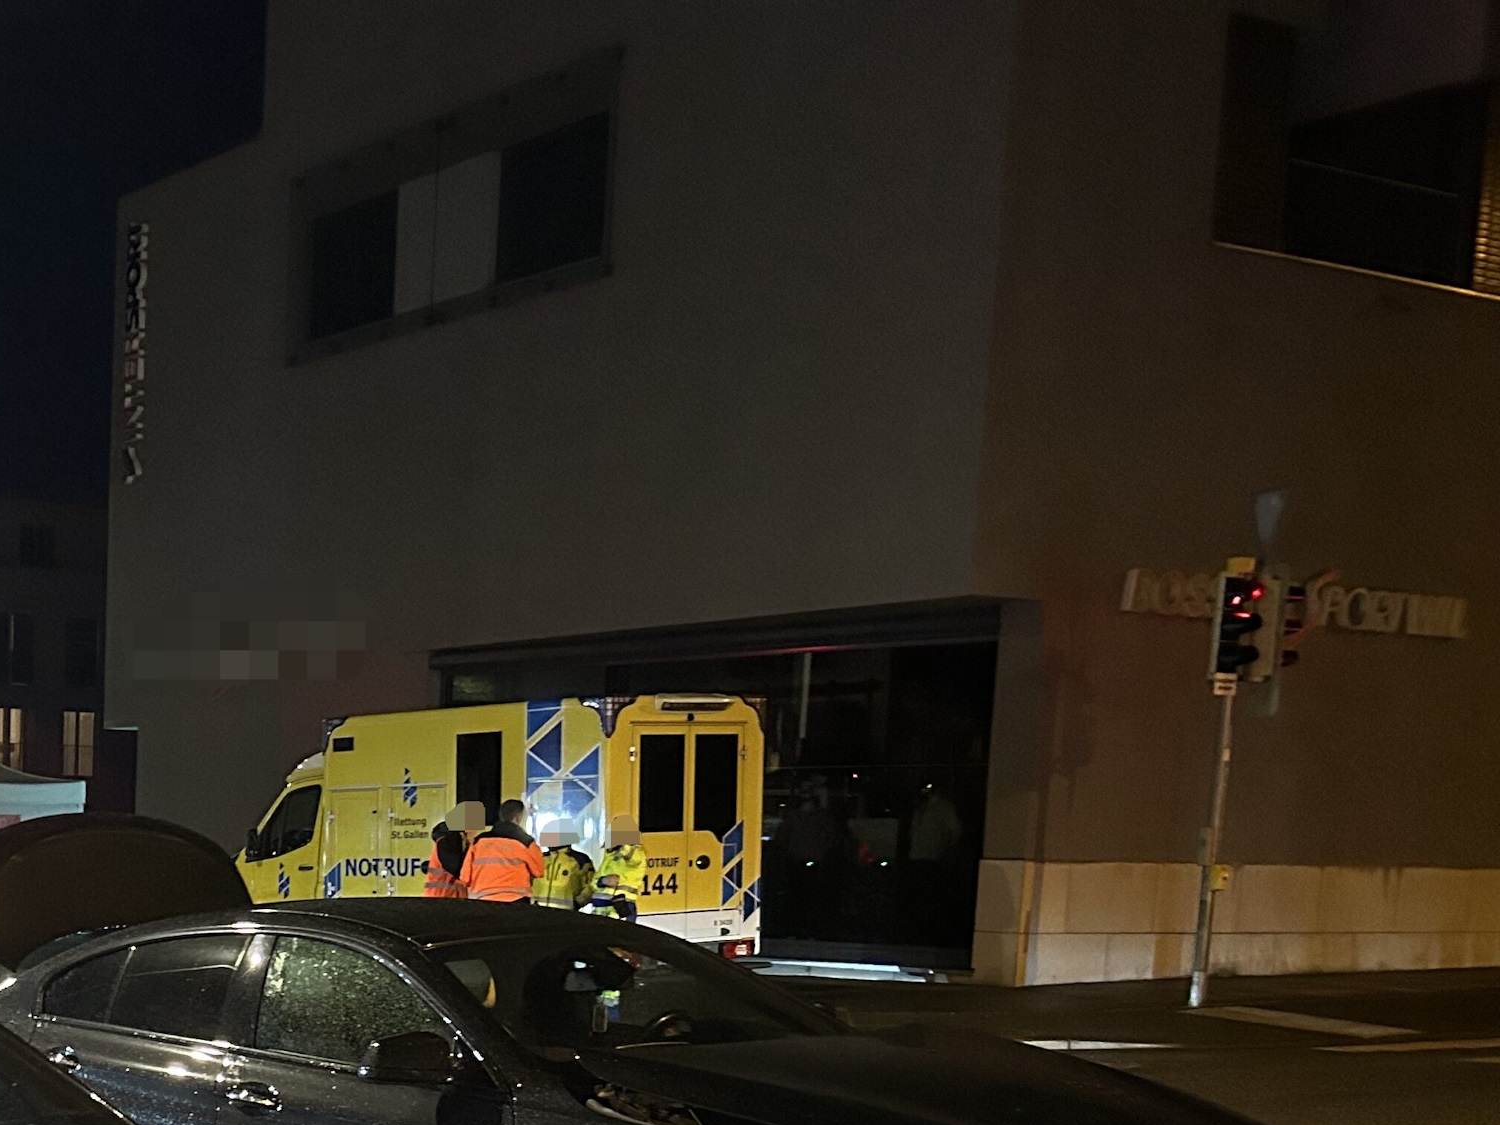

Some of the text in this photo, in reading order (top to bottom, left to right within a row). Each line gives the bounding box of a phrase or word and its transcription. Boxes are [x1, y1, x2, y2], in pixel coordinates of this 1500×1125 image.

[345, 858, 421, 877] NOTRUF
[646, 858, 679, 868] OTRUF
[640, 873, 678, 896] 144
